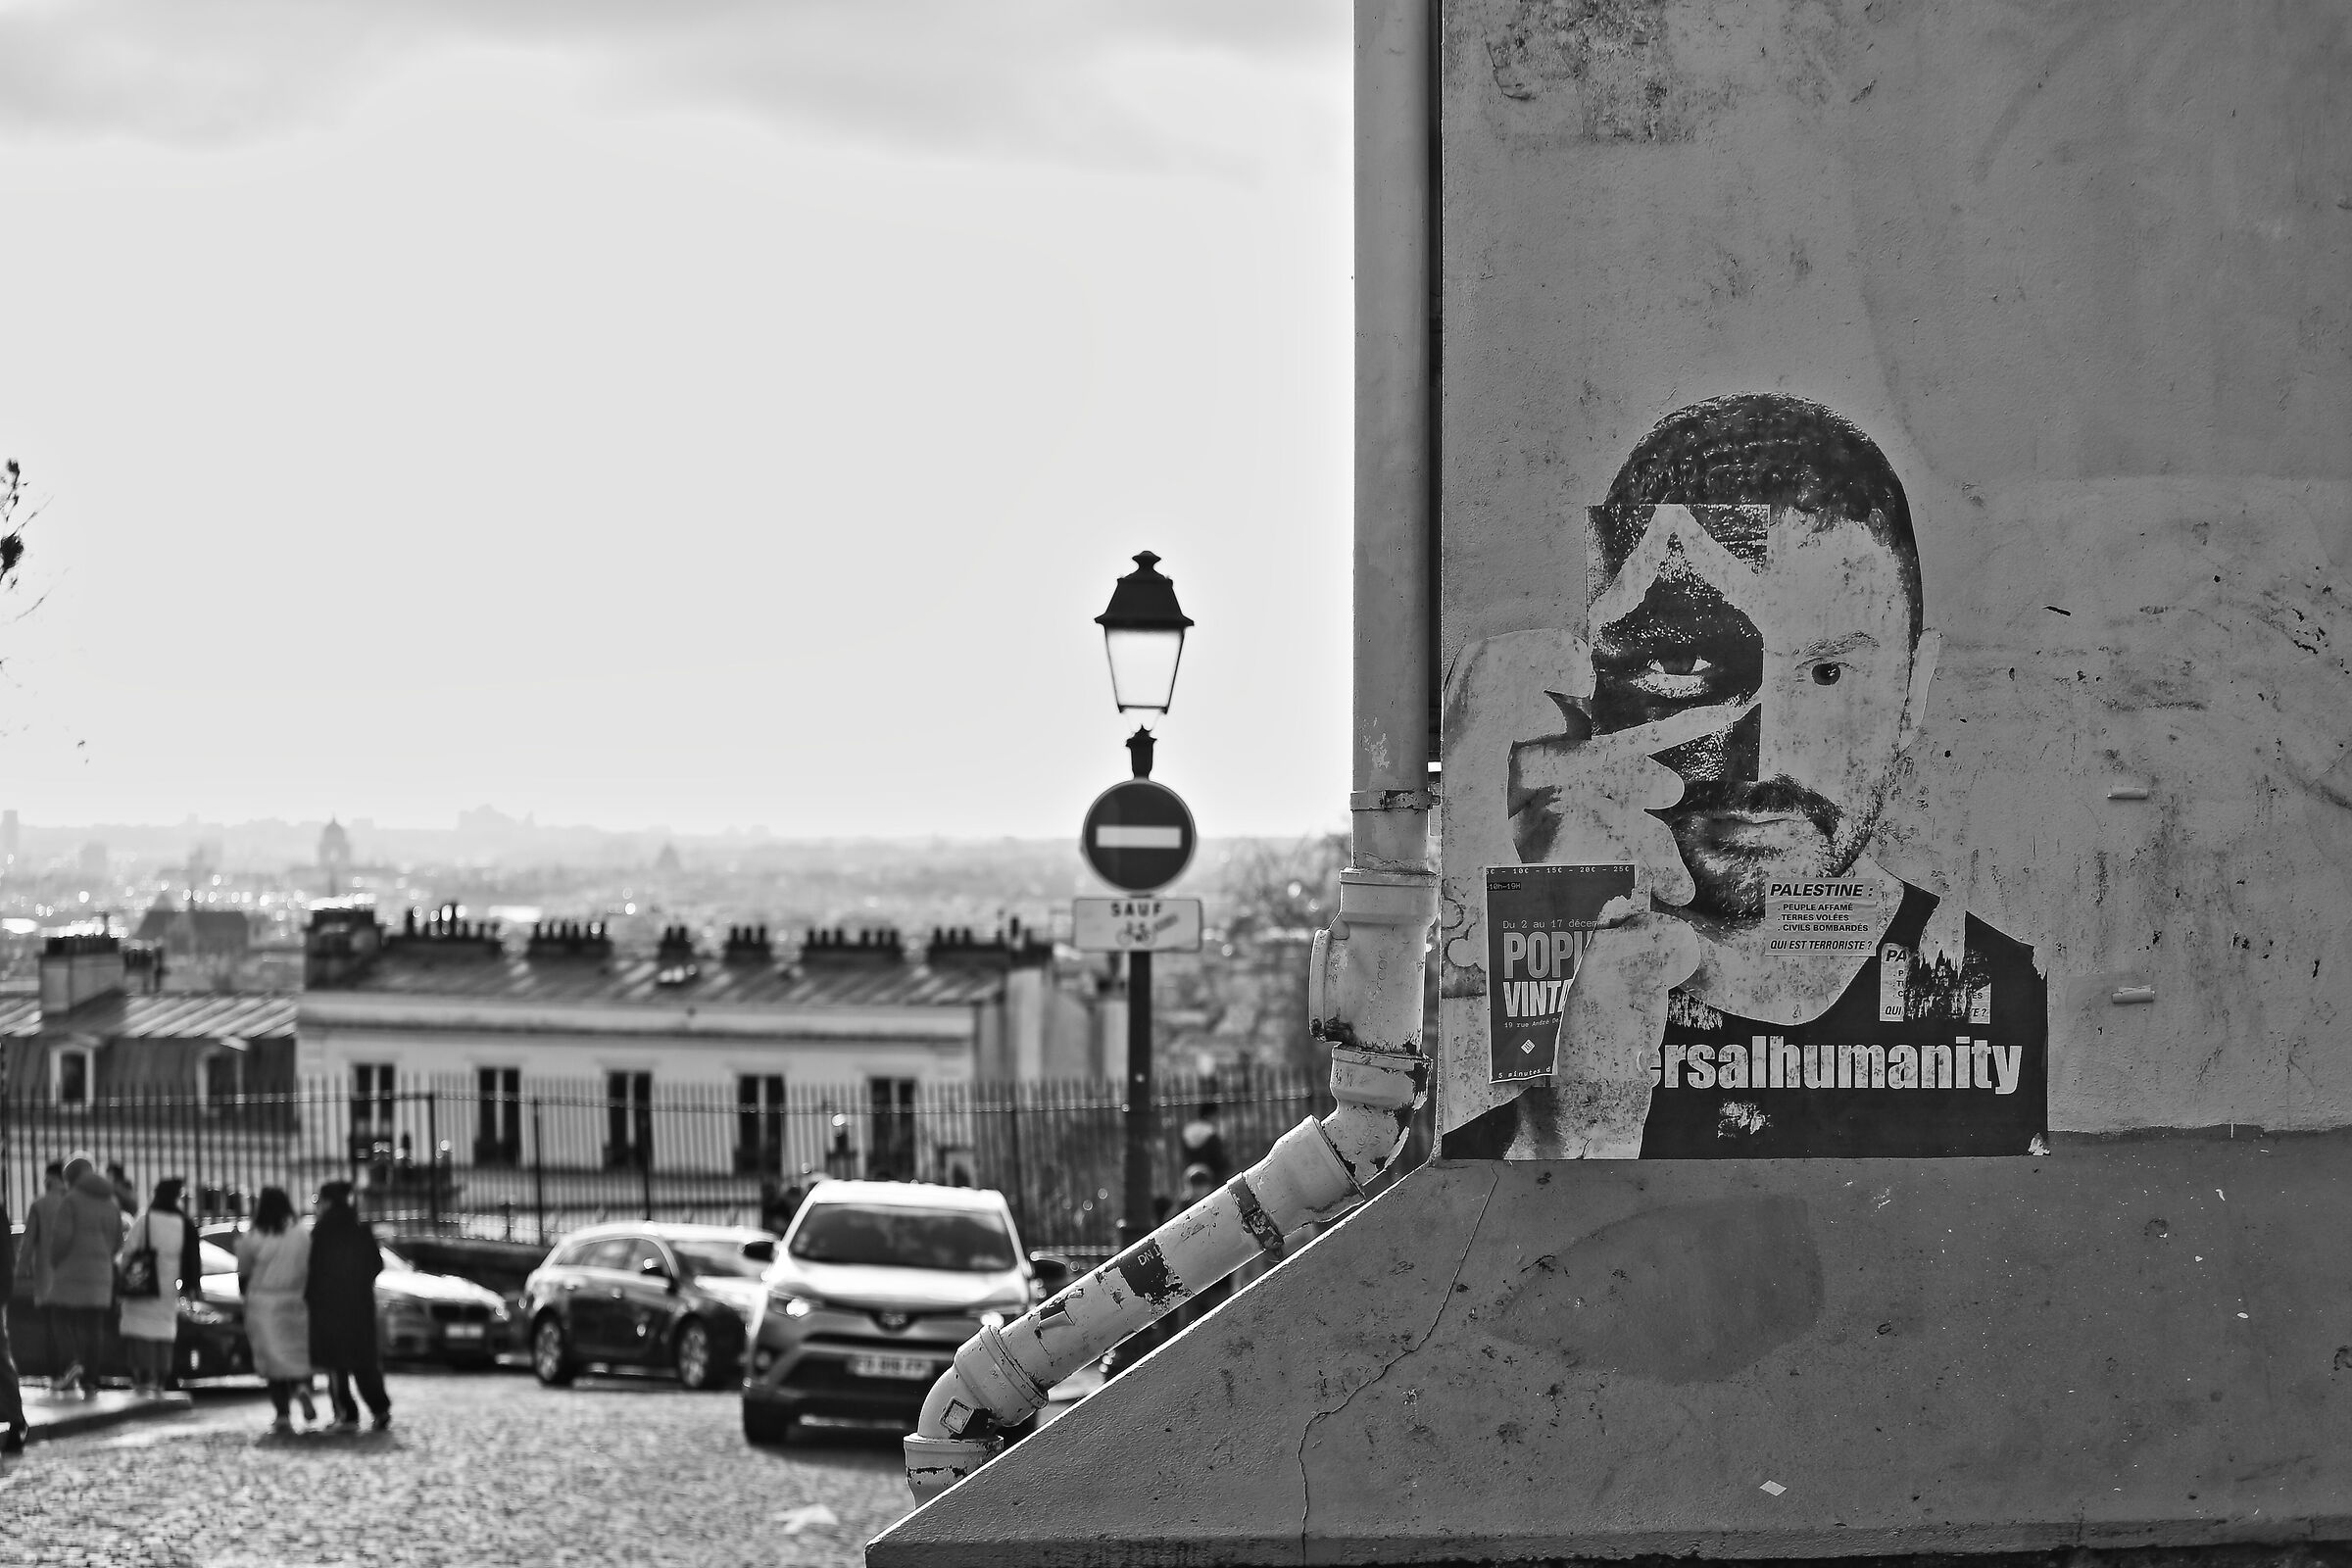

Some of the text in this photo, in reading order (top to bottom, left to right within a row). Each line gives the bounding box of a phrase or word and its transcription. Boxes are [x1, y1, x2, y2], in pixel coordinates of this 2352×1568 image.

[1770, 883, 1864, 897] PALESTINE
[1110, 902, 1161, 917] SAUF
[1818, 902, 1854, 911] AFFAMÉ
[1816, 911, 1849, 921] VOLÉES
[1502, 920, 1515, 929] Du
[1521, 919, 1528, 928] 2
[1551, 919, 1562, 928] 17
[1813, 922, 1869, 932] BOMBARDÉS
[1770, 940, 1873, 951] QUI EST TERRORISTE ?
[1886, 1005, 1902, 1015] QUI
[1508, 1068, 1541, 1078] minutes
